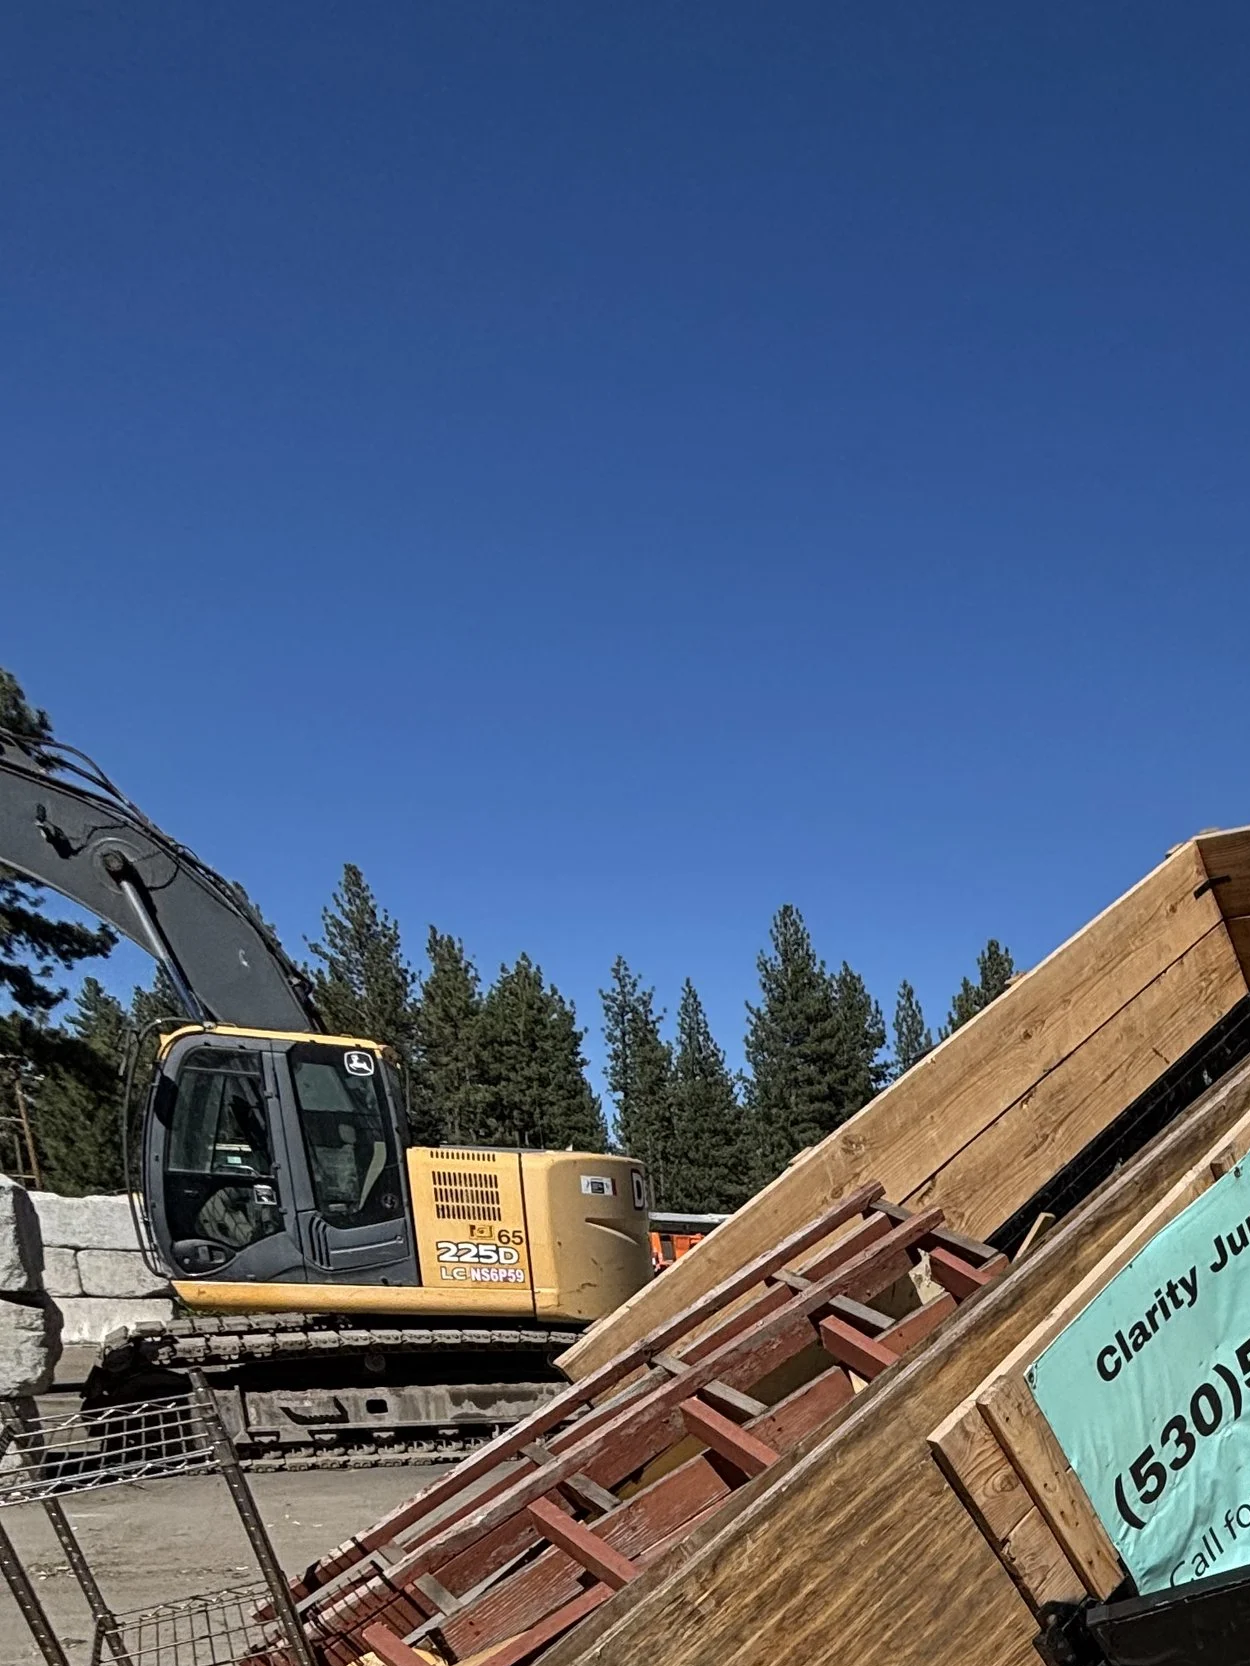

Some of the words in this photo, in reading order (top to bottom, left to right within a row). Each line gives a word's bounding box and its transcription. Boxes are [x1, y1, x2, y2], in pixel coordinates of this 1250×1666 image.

[497, 1228, 524, 1246] 65
[436, 1240, 519, 1265] 225D
[440, 1265, 467, 1280] LC
[470, 1267, 525, 1283] NS6P59
[1096, 1265, 1198, 1382] Clarity
